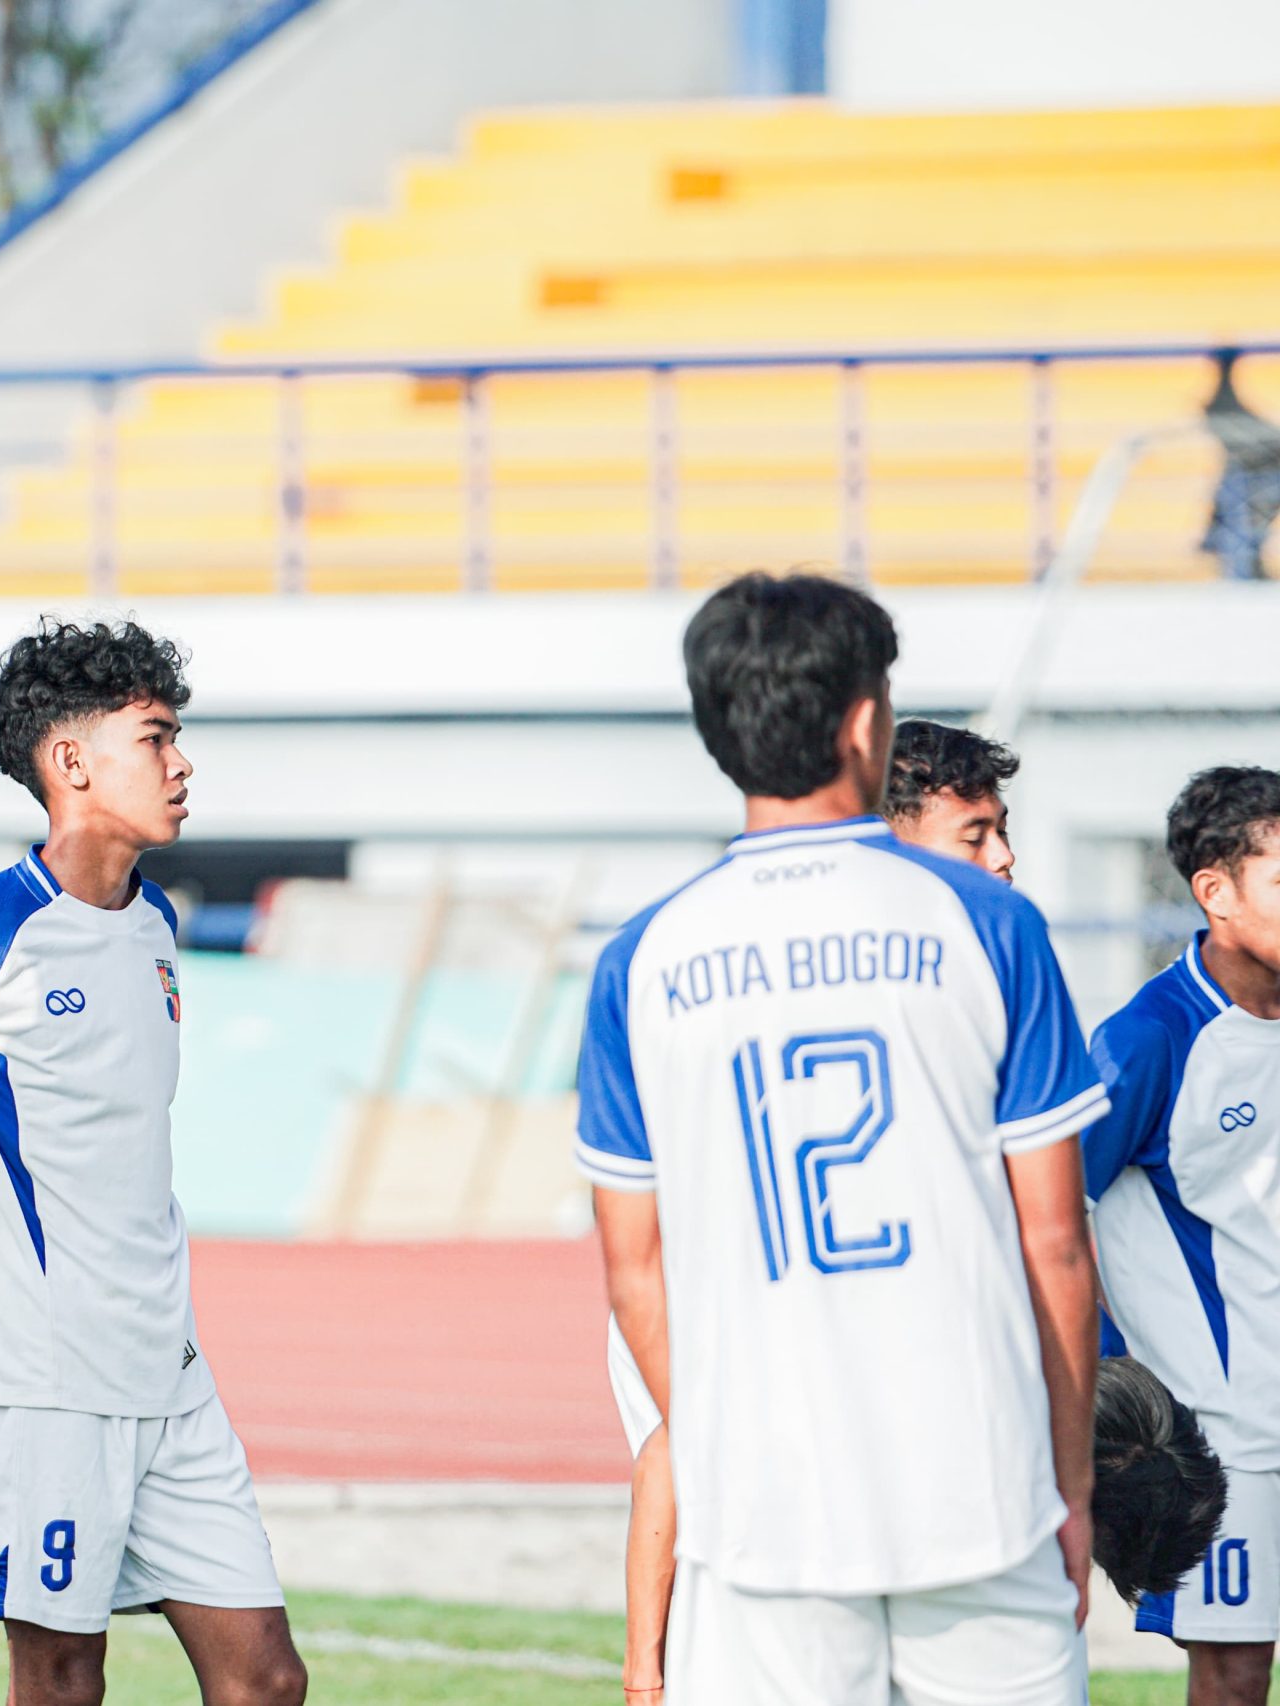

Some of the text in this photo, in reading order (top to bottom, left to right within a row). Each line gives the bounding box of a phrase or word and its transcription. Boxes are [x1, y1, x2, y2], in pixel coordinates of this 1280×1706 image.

[661, 931, 944, 1018] KOTA BOGOR
[732, 1028, 911, 1282] 12
[40, 1519, 76, 1592] 9
[1204, 1538, 1249, 1606] 10
